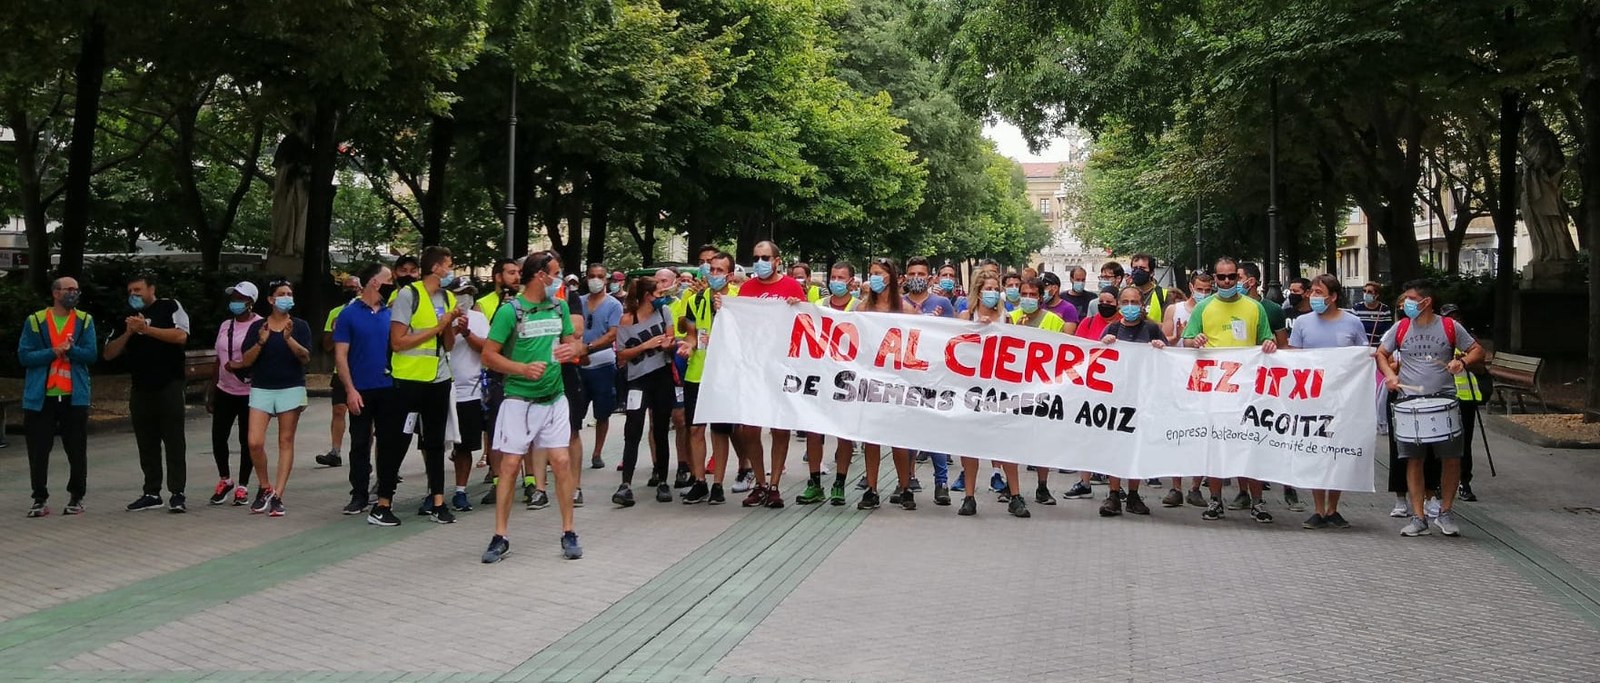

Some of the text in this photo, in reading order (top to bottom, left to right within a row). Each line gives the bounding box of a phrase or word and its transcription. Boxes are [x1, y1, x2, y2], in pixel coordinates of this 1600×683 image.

[787, 313, 1120, 394] NO AL CIERRE
[1186, 359, 1243, 393] EZ
[783, 374, 821, 396] DE
[963, 387, 1064, 420] GAMESA
[1075, 401, 1137, 433] AOIZ
[1240, 405, 1335, 438] AGOITZ
[1166, 426, 1208, 445] enpresa
[1269, 439, 1304, 450] comité
[1305, 441, 1318, 453] de
